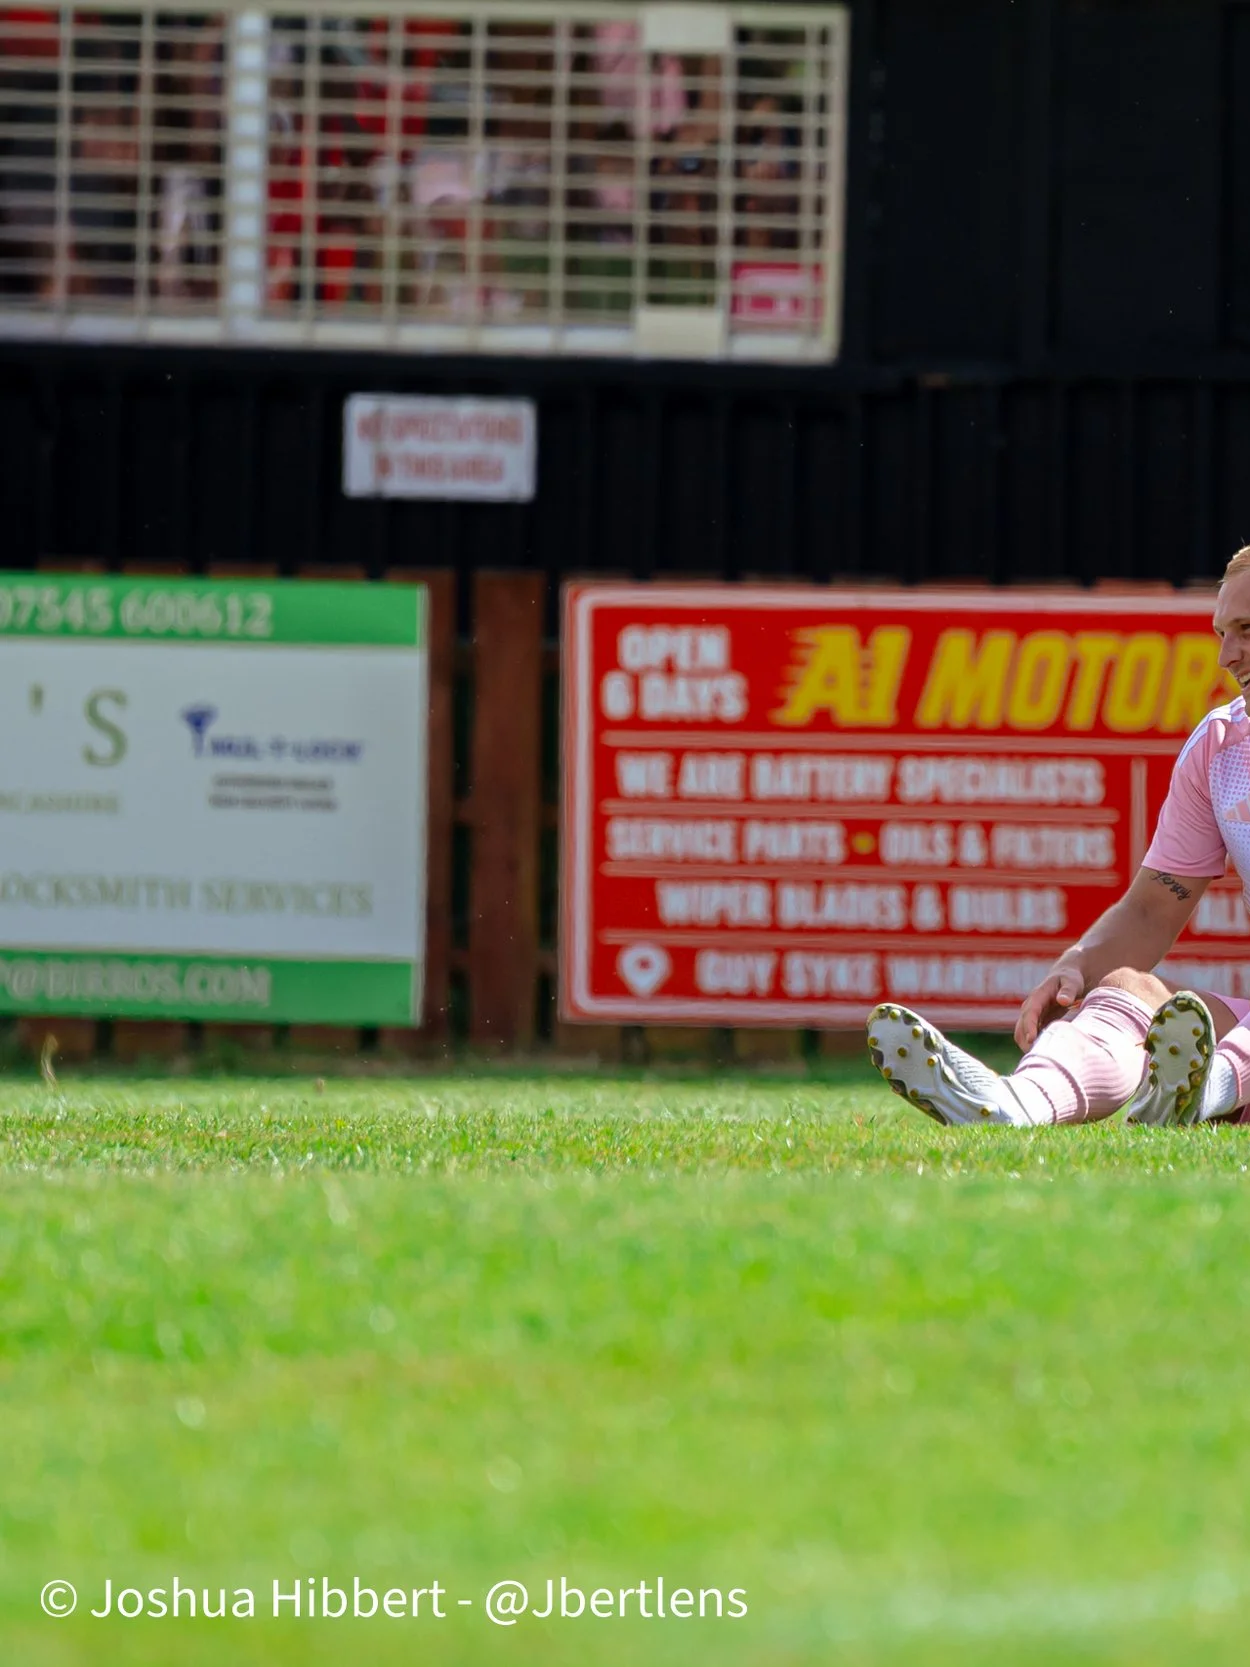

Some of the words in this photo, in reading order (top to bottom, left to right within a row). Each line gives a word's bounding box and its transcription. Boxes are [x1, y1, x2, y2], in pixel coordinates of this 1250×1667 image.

[620, 628, 729, 667] OPEN
[640, 672, 746, 720] DAYS
[617, 755, 672, 795] WE
[680, 756, 743, 796] ARE
[751, 757, 892, 798] BATTERY
[898, 759, 1103, 801] SPECIALISTS
[608, 819, 737, 859] SERVICE
[743, 822, 846, 860] PARTS
[881, 824, 952, 862] OILS
[959, 824, 985, 864] &
[991, 825, 1113, 865] FILTERS
[657, 882, 771, 923] WIPER
[777, 883, 905, 927] BLADES
[913, 886, 942, 928] &
[949, 887, 1064, 930] BULBS
[696, 952, 776, 992] GUY
[784, 954, 879, 993] SYKE
